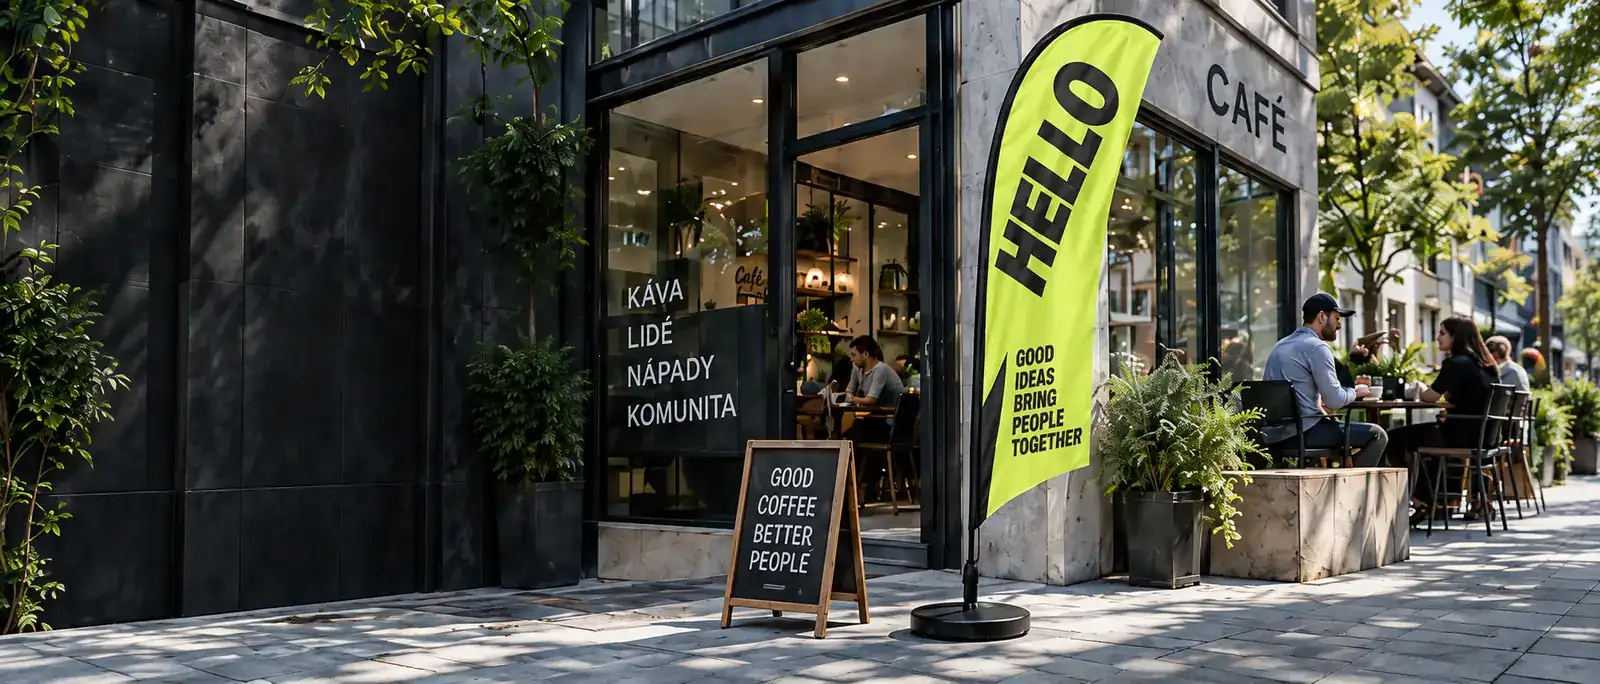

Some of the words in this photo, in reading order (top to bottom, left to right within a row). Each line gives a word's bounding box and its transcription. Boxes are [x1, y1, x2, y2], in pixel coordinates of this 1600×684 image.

[1206, 63, 1286, 154] CAFÉ
[994, 61, 1119, 298] HELLO
[735, 266, 765, 291] Café
[627, 279, 684, 309] KÁVA
[627, 315, 673, 349] LIDÉ
[1015, 345, 1055, 368] GOOD
[627, 354, 715, 388] NÁPADY
[1014, 367, 1055, 390] IDEAS
[627, 393, 737, 428] KOMUNITA
[1013, 388, 1057, 413] BRING
[1011, 408, 1065, 436] PEOPLE
[1011, 427, 1083, 457] TOGETHER
[770, 467, 814, 488] GOOD
[757, 494, 818, 517] COFFEE
[753, 523, 813, 546] BETTER
[749, 550, 811, 574] PEOPLE
